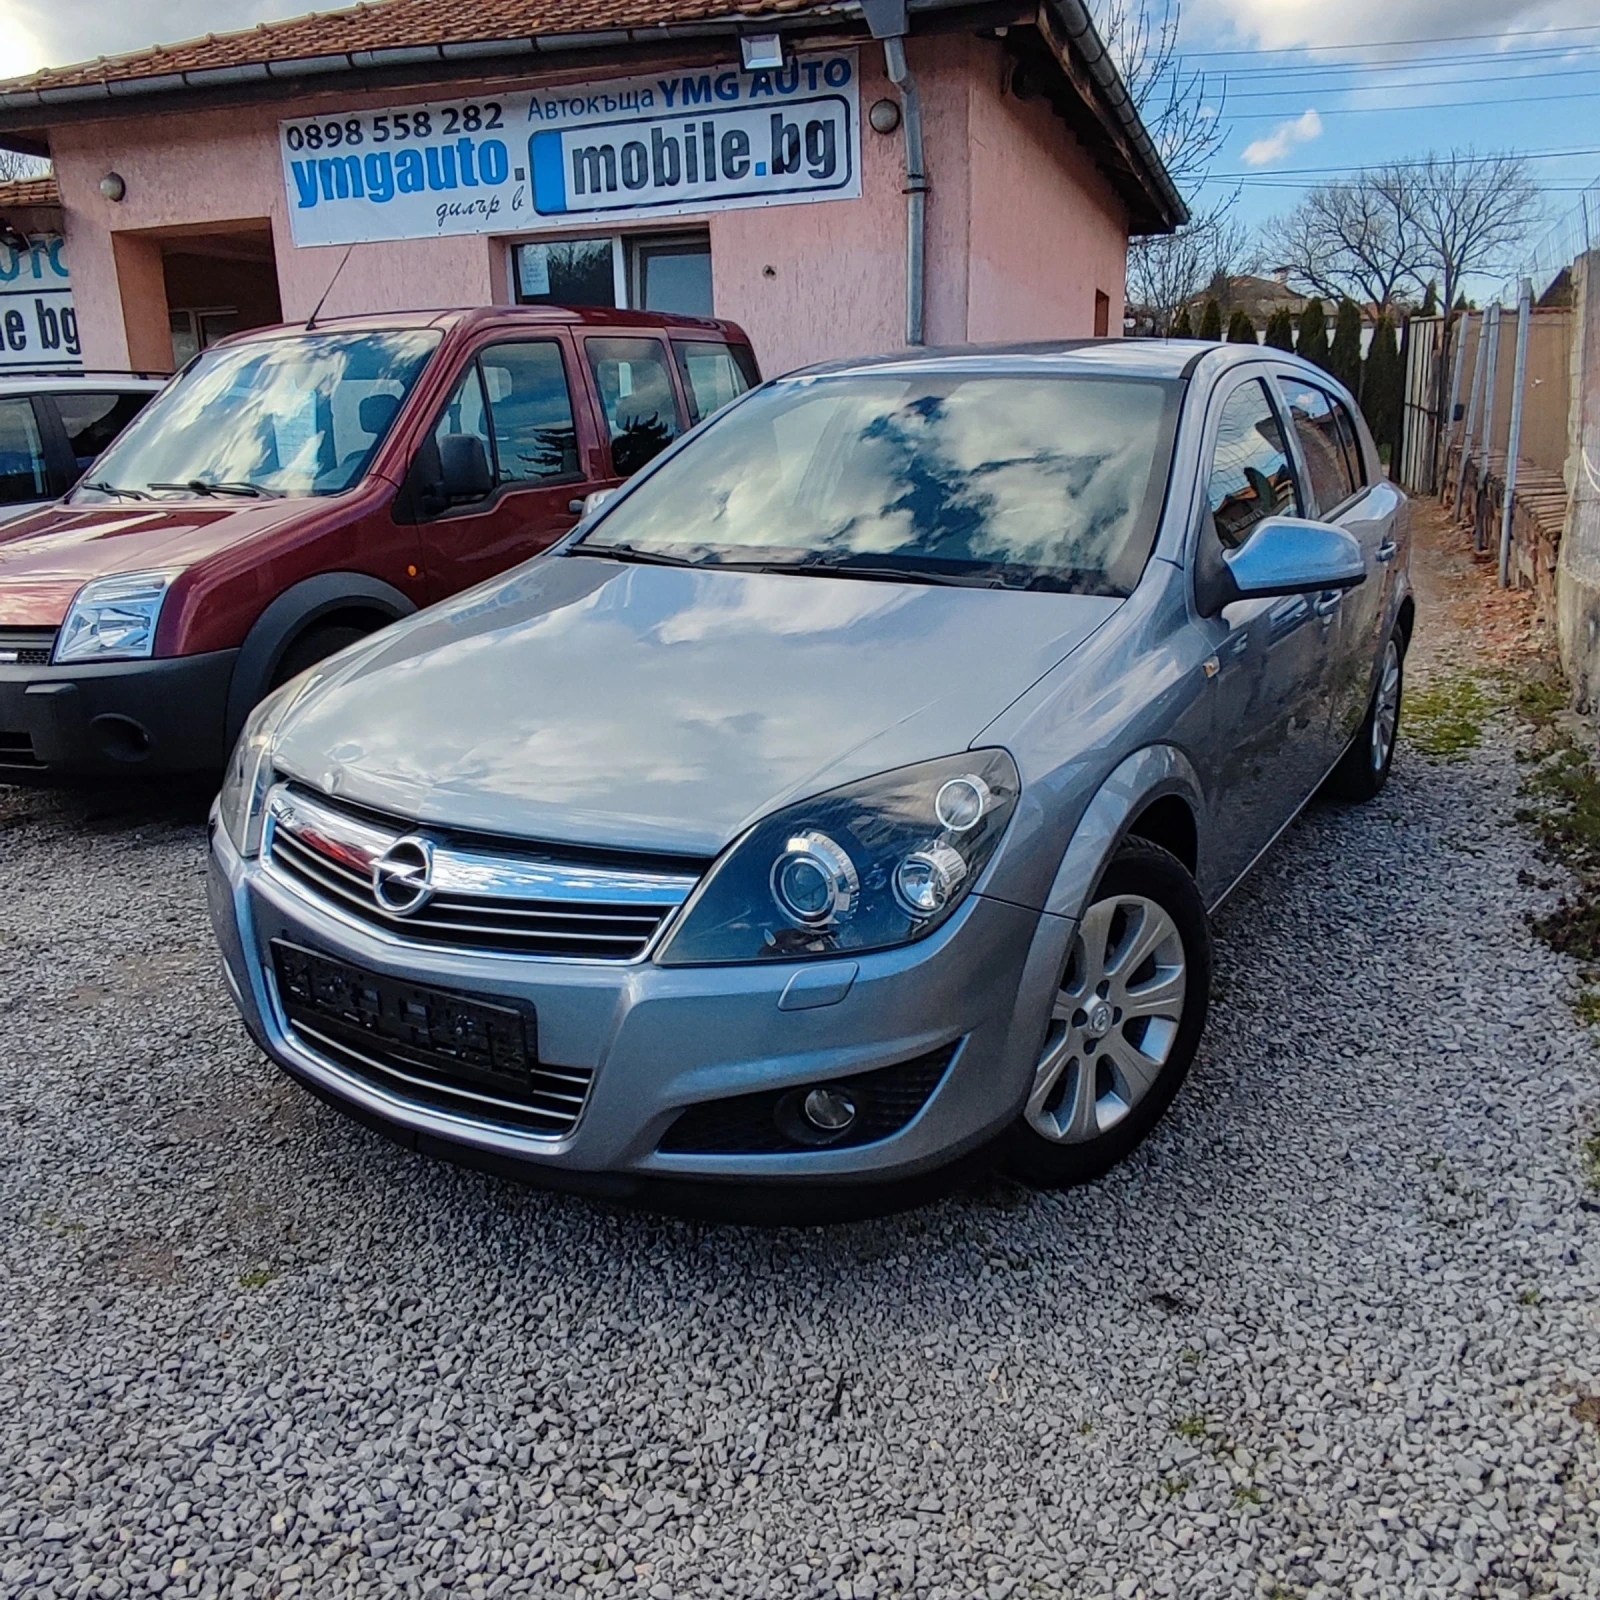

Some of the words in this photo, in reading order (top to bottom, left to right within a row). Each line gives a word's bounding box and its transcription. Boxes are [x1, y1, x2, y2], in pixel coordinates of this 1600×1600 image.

[528, 88, 654, 122] Автокъща
[657, 75, 739, 107] YMG
[749, 57, 851, 97] AUTO
[287, 119, 363, 151] 0898
[373, 111, 432, 142] 558
[441, 102, 504, 135] 282
[572, 113, 836, 194] mobile.bg
[436, 195, 501, 226] дилър
